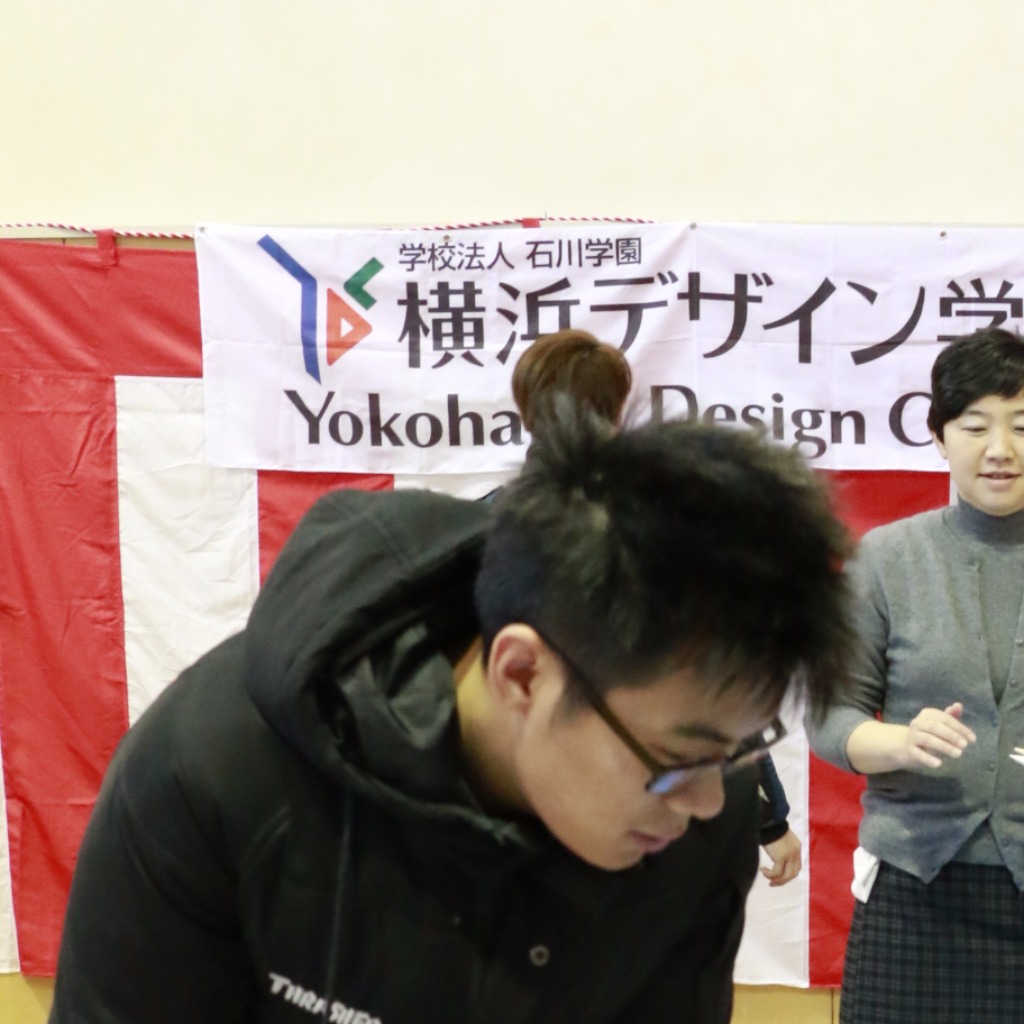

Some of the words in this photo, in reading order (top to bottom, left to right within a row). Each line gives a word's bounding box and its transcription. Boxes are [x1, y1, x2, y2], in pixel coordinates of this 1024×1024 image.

[398, 241, 515, 272] 学校法人
[525, 237, 642, 269] 石川学園
[284, 389, 525, 448] Yokoha
[650, 384, 866, 460] Design
